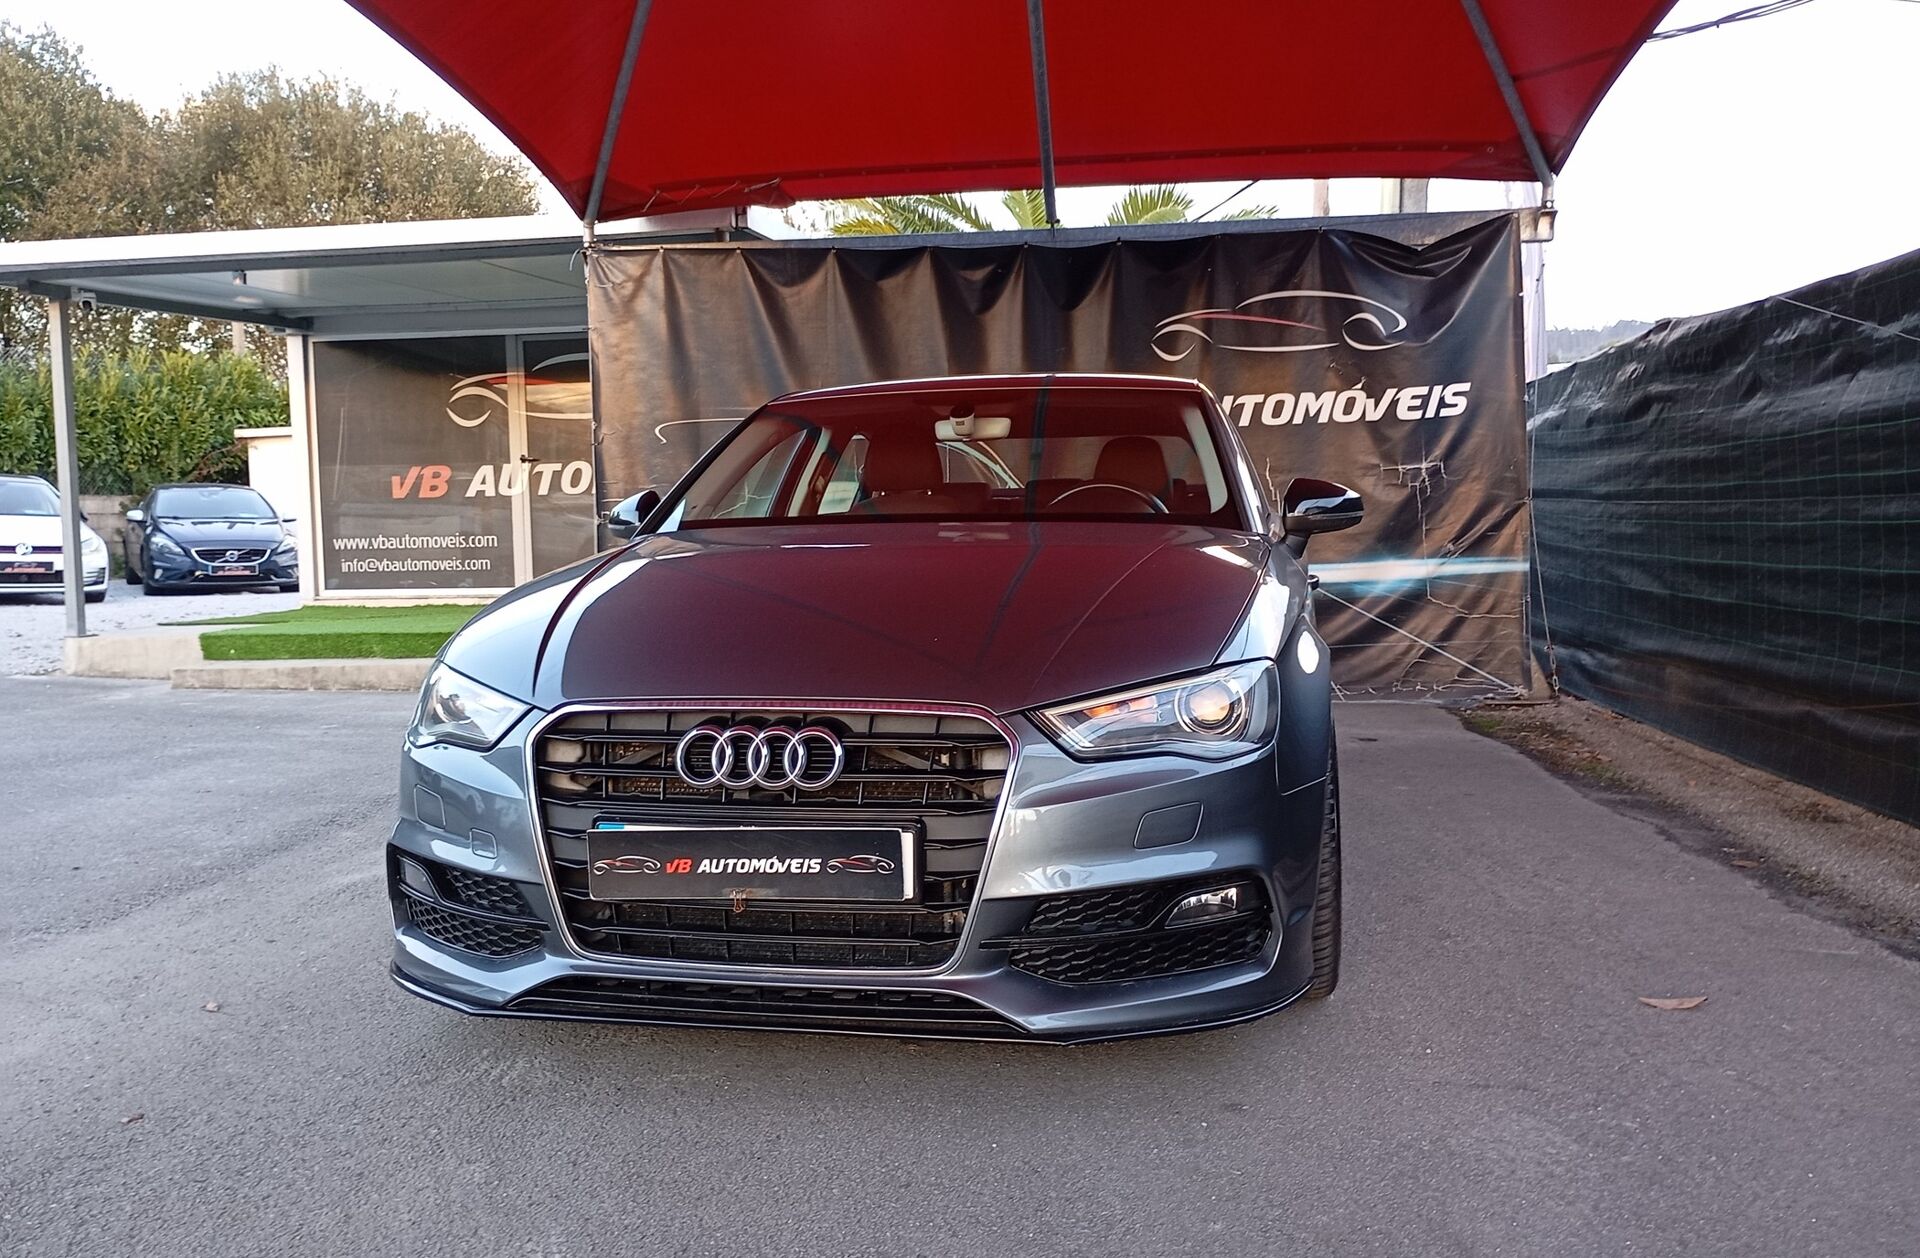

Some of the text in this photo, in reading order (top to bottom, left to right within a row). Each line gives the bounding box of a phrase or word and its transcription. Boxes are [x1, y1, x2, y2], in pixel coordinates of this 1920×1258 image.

[391, 460, 596, 499] VB AUTO
[333, 533, 498, 550] www.vbautomoveis.com
[341, 557, 491, 573] info@vbautomoveis.com
[666, 855, 822, 874] VB AUTOMÓVEIS
